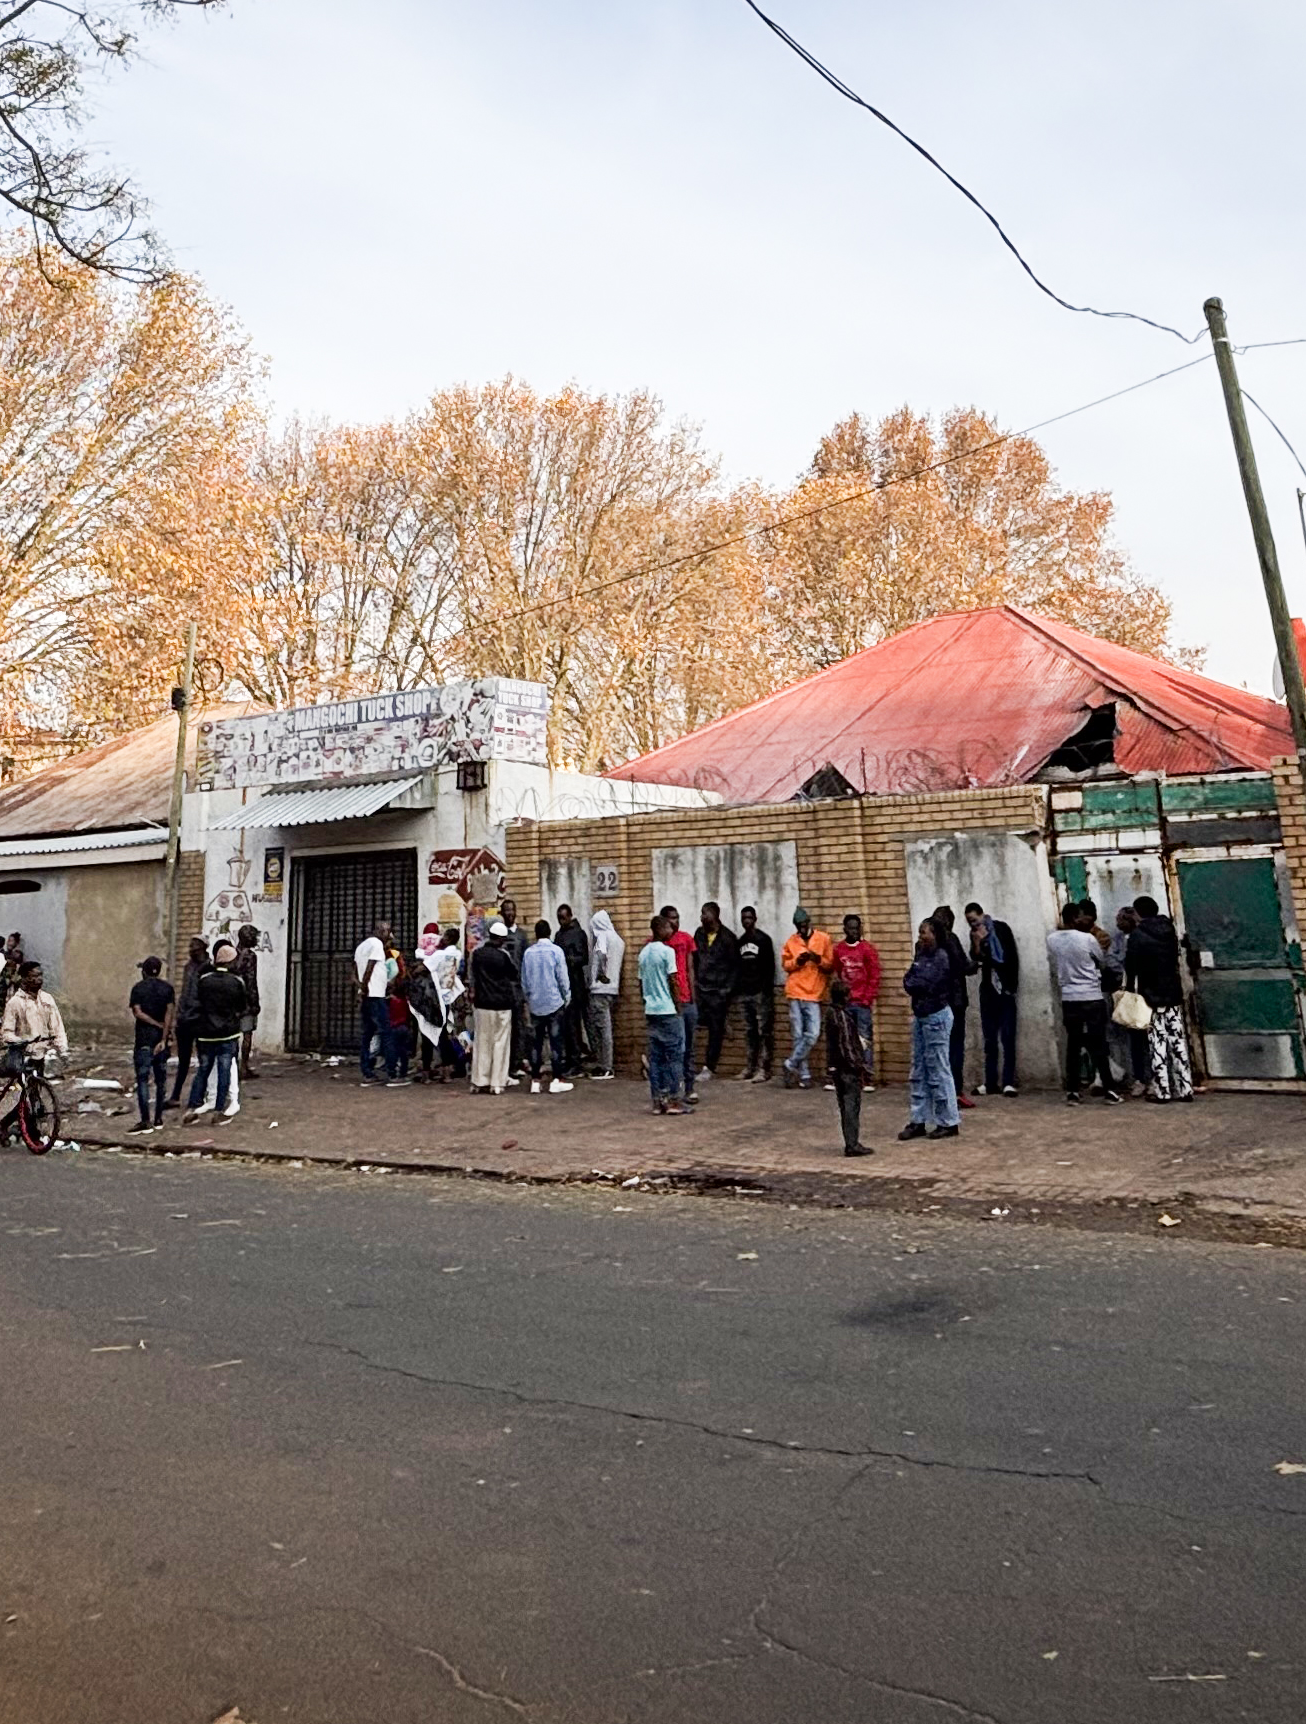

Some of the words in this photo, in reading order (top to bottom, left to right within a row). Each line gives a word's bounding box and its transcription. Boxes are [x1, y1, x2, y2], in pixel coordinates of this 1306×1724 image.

[294, 701, 358, 732] MANGOCHI
[360, 697, 395, 722] TUCK
[395, 691, 432, 717] SHOP
[597, 871, 618, 892] 22
